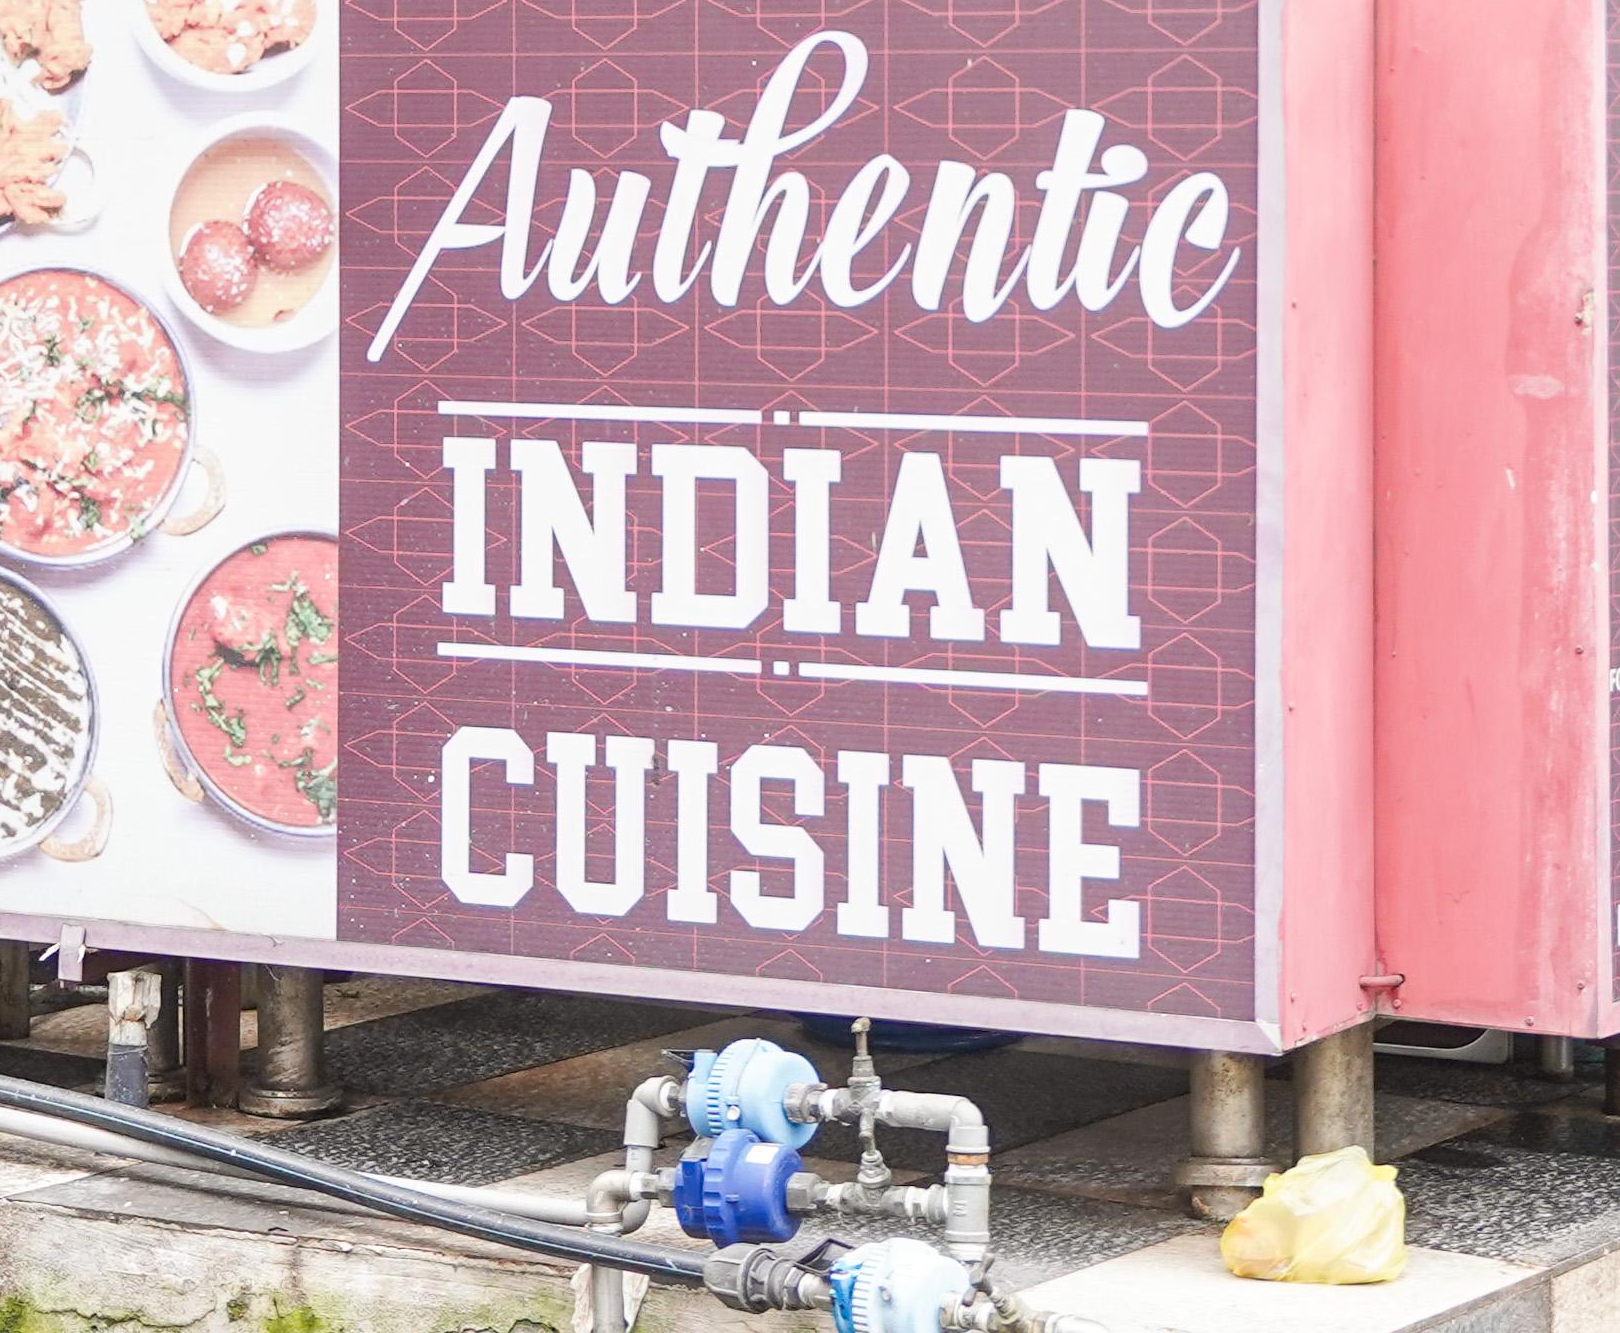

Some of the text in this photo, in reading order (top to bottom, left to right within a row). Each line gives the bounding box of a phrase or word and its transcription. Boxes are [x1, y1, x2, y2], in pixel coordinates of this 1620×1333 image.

[367, 30, 1241, 363] Authentic
[441, 437, 1142, 650] INDIAN
[441, 725, 1142, 960] CUISINE
